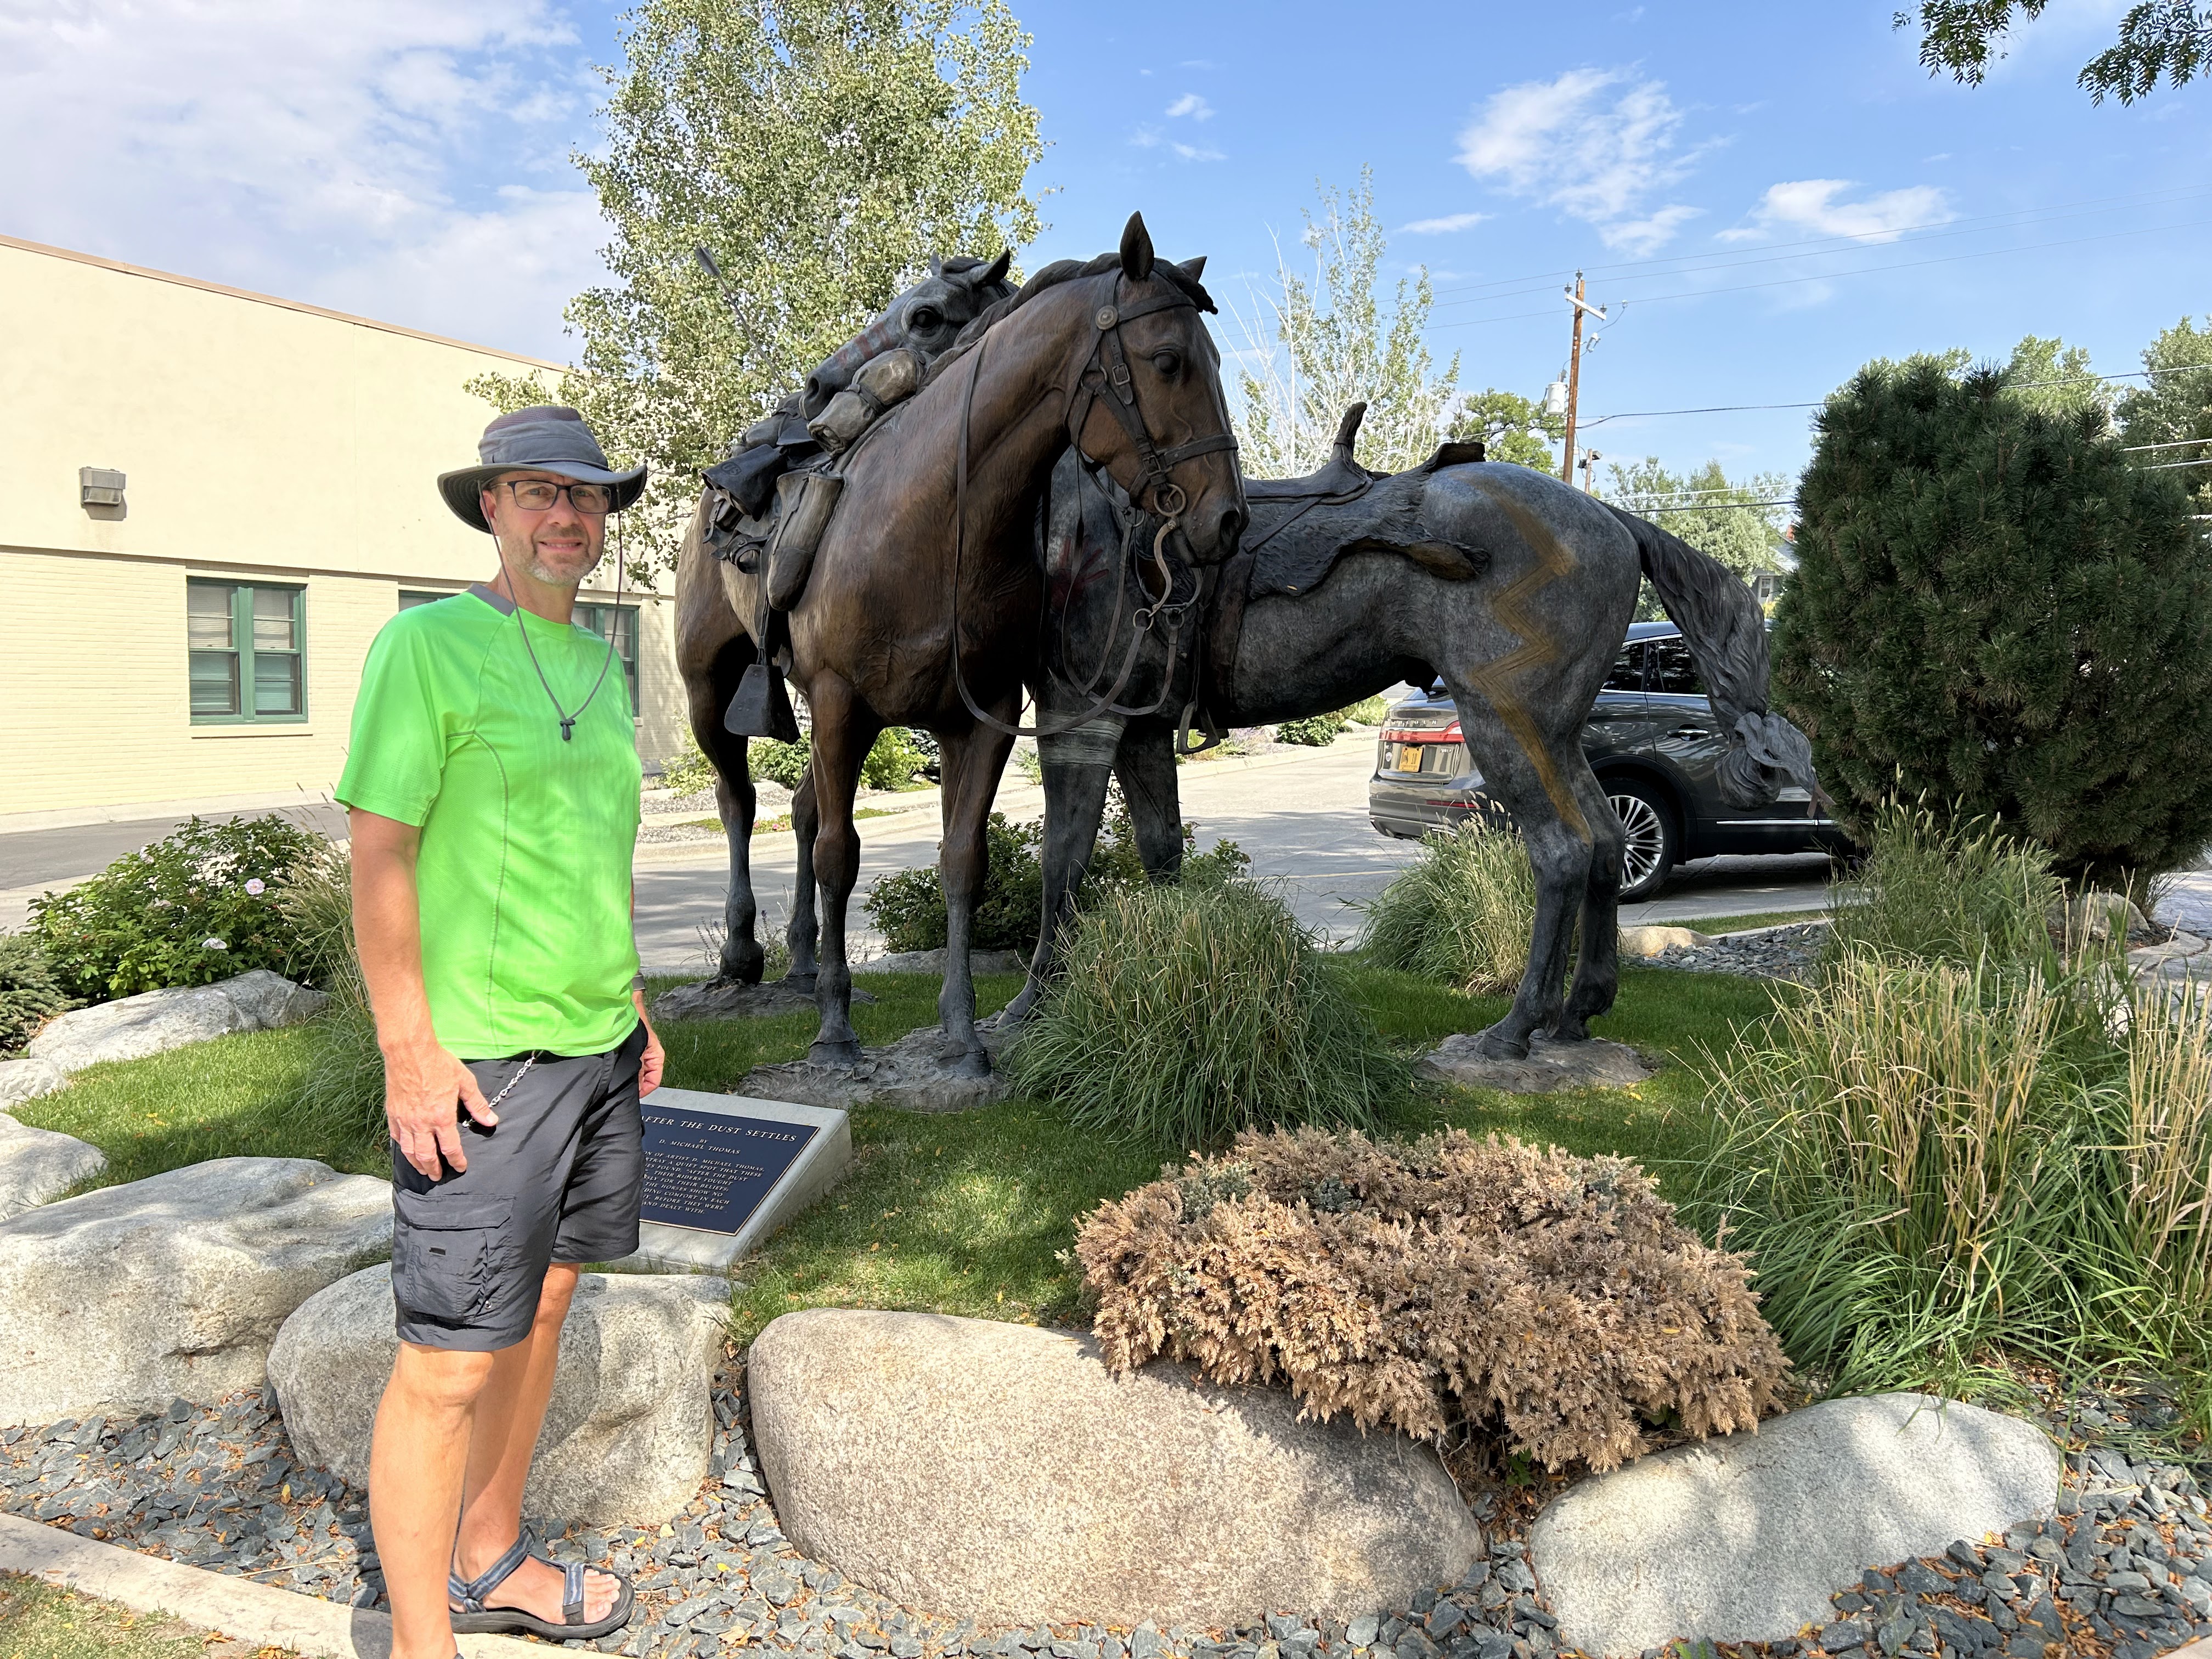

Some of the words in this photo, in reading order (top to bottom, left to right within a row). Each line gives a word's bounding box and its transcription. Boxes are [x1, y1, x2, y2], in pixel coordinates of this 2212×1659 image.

[680, 1120, 704, 1129] THE
[708, 1125, 742, 1134] DUST
[746, 1130, 797, 1141] SETTLES
[670, 1141, 704, 1149] MICHAEL
[708, 1146, 741, 1154] THOMAS
[664, 1191, 697, 1200] COMFORT
